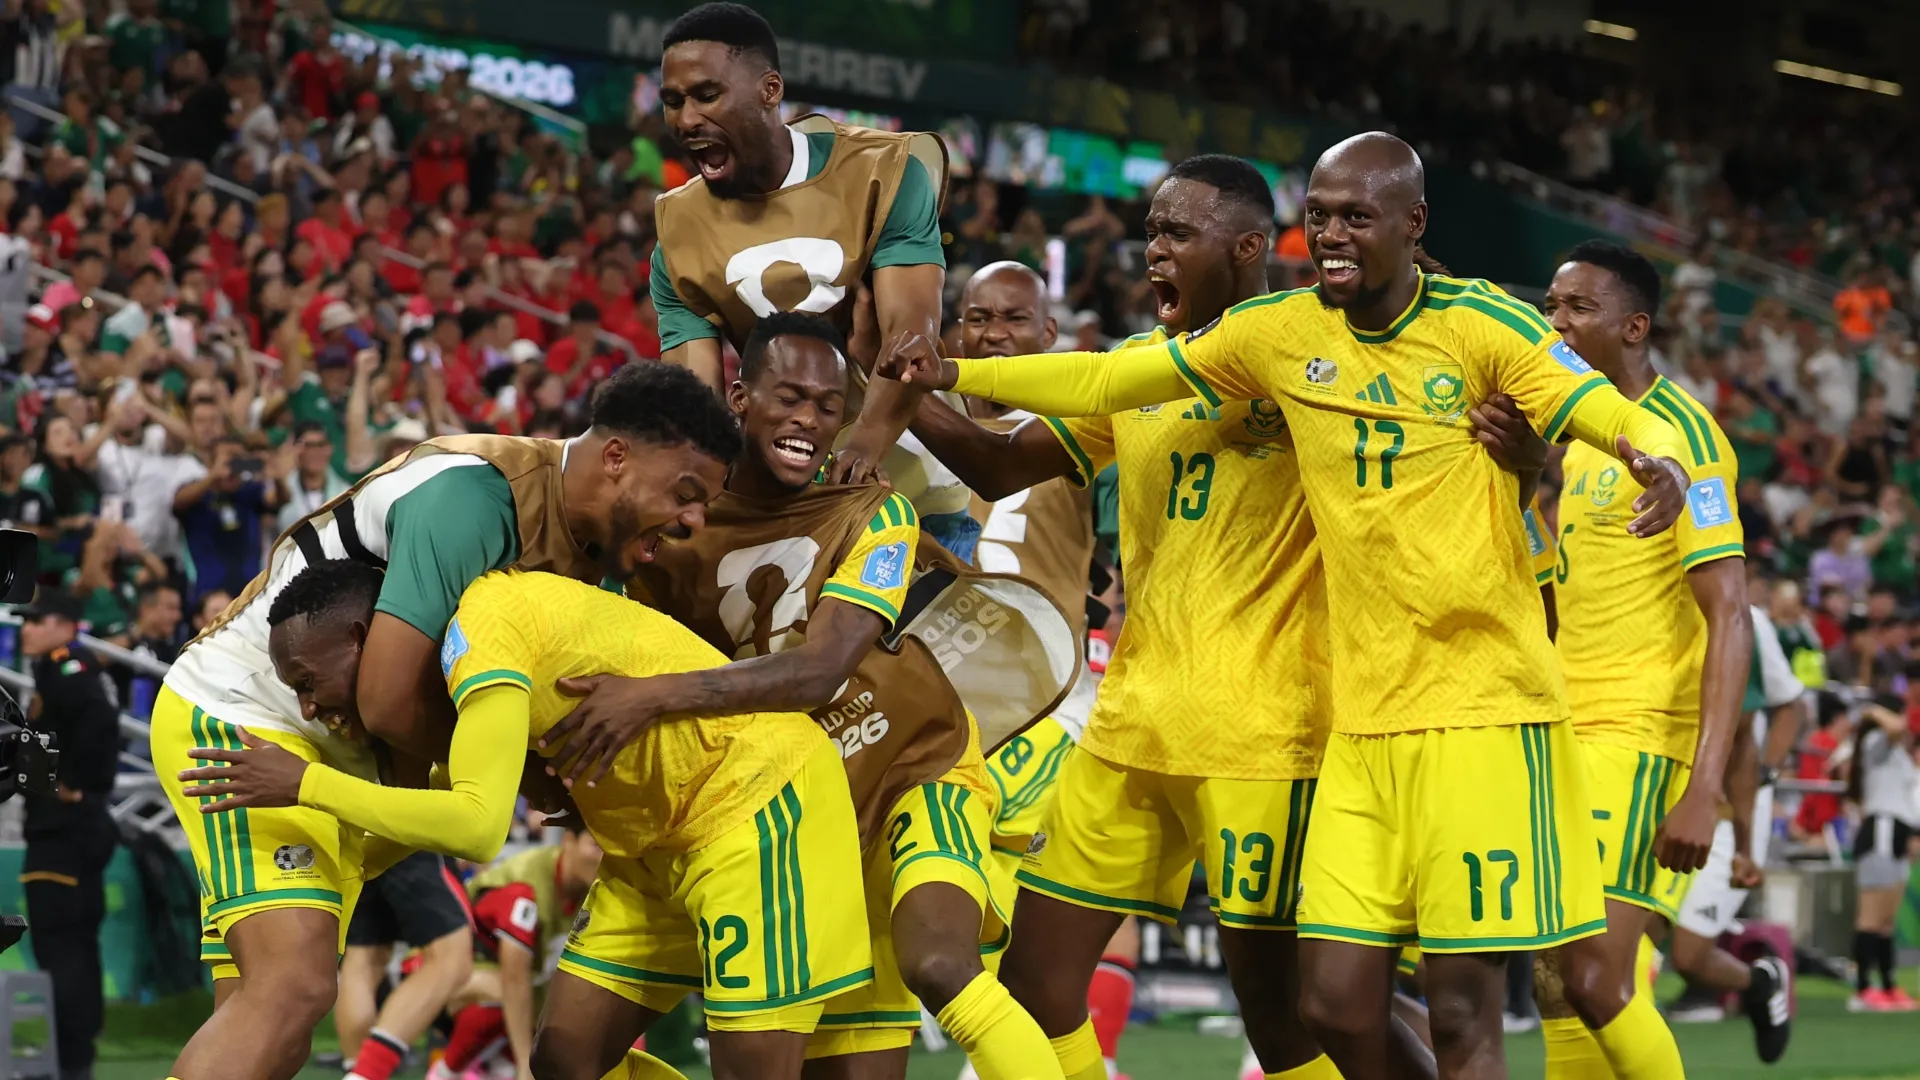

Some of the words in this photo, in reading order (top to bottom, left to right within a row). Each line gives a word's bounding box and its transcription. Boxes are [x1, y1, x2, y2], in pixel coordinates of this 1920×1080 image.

[467, 52, 577, 107] 2026
[608, 11, 927, 98] MERREY
[1167, 451, 1215, 520] 13
[1354, 417, 1405, 489] 17
[875, 566, 893, 581] PEACE
[841, 691, 873, 719] CUP
[1000, 736, 1034, 776] 8
[887, 812, 918, 862] 2
[1220, 828, 1274, 902] 13
[1463, 849, 1519, 921] 17
[699, 915, 750, 988] 12
